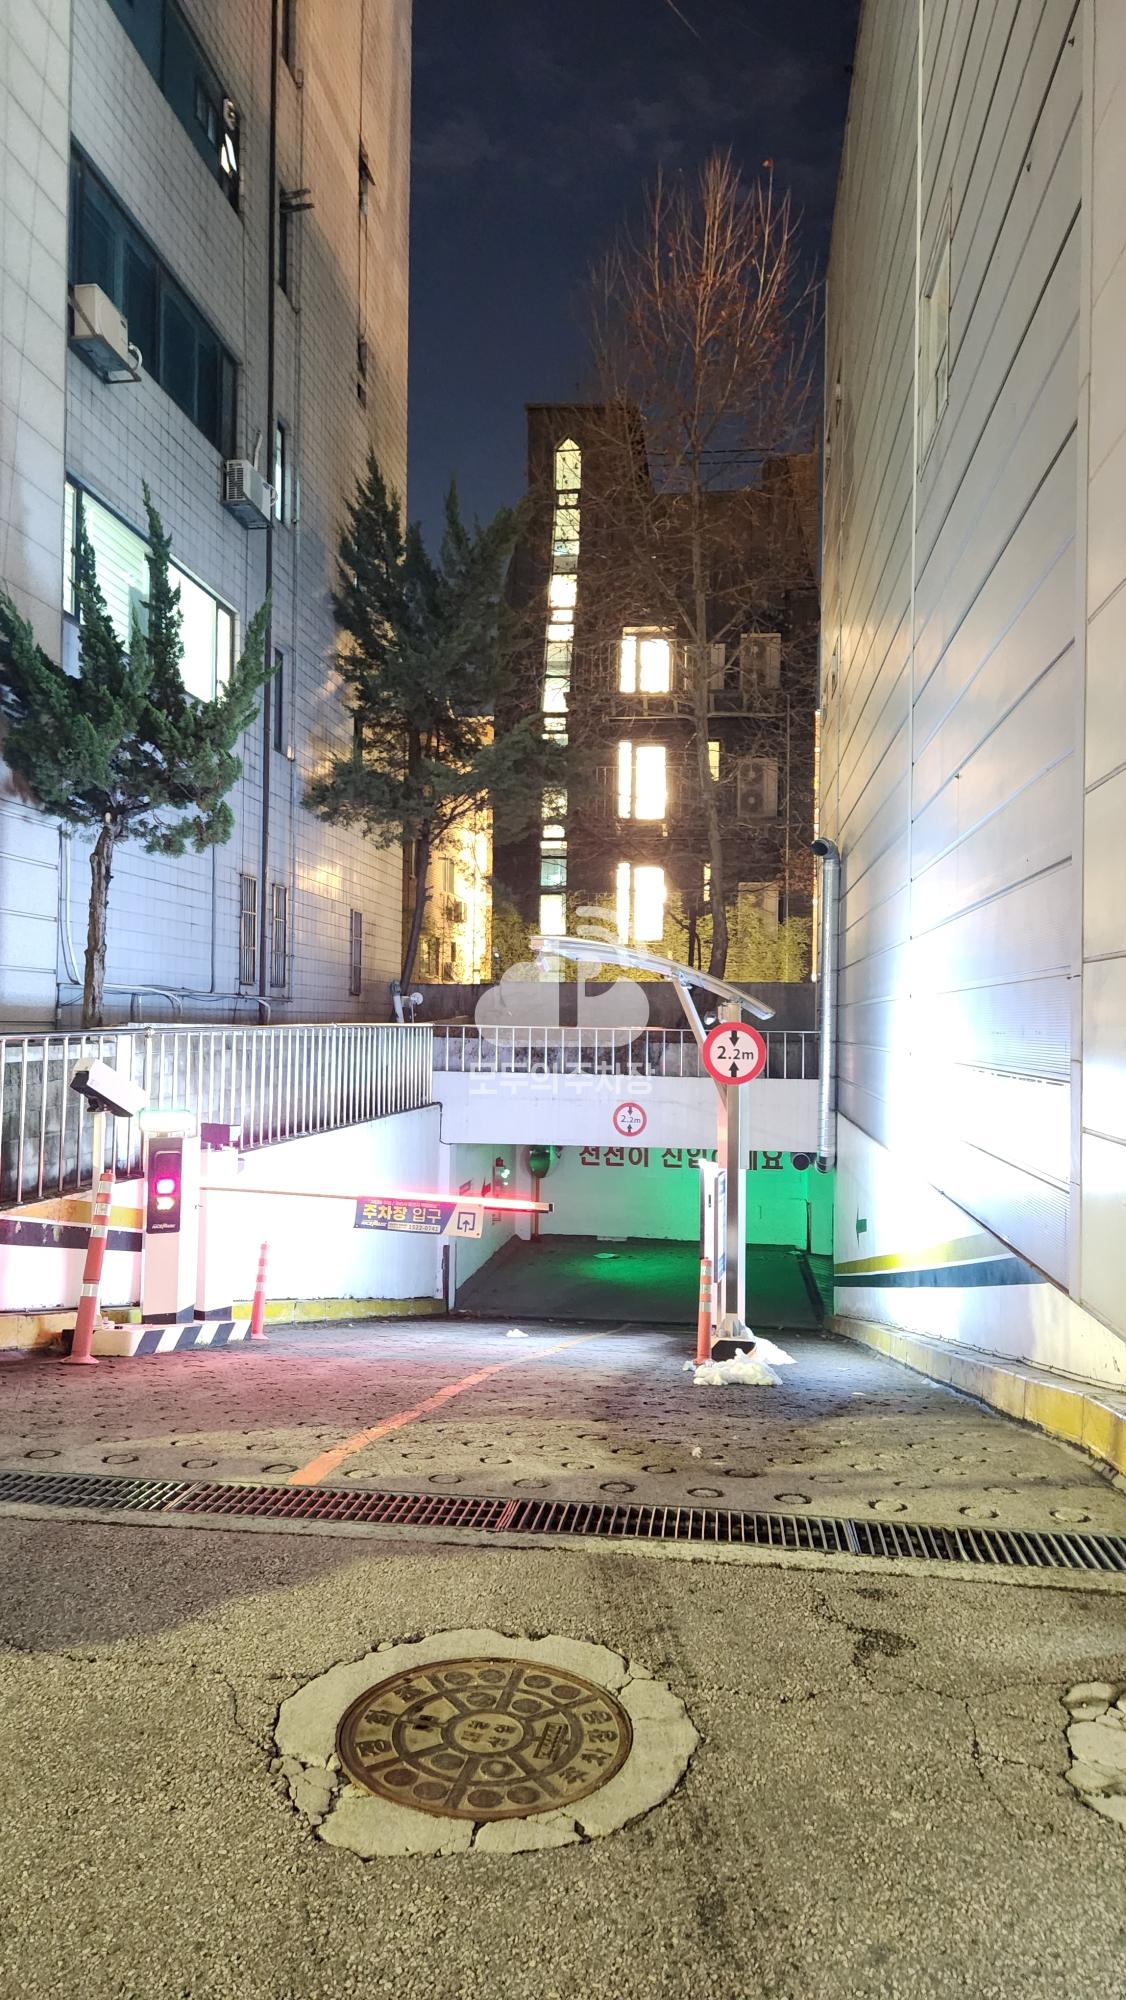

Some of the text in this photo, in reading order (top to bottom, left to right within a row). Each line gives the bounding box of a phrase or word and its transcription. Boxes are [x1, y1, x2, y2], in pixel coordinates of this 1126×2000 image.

[716, 1045, 755, 1061] 2.2m
[619, 1114, 642, 1125] 2.2m
[362, 1203, 408, 1221] 주차장
[412, 1207, 442, 1224] 입구
